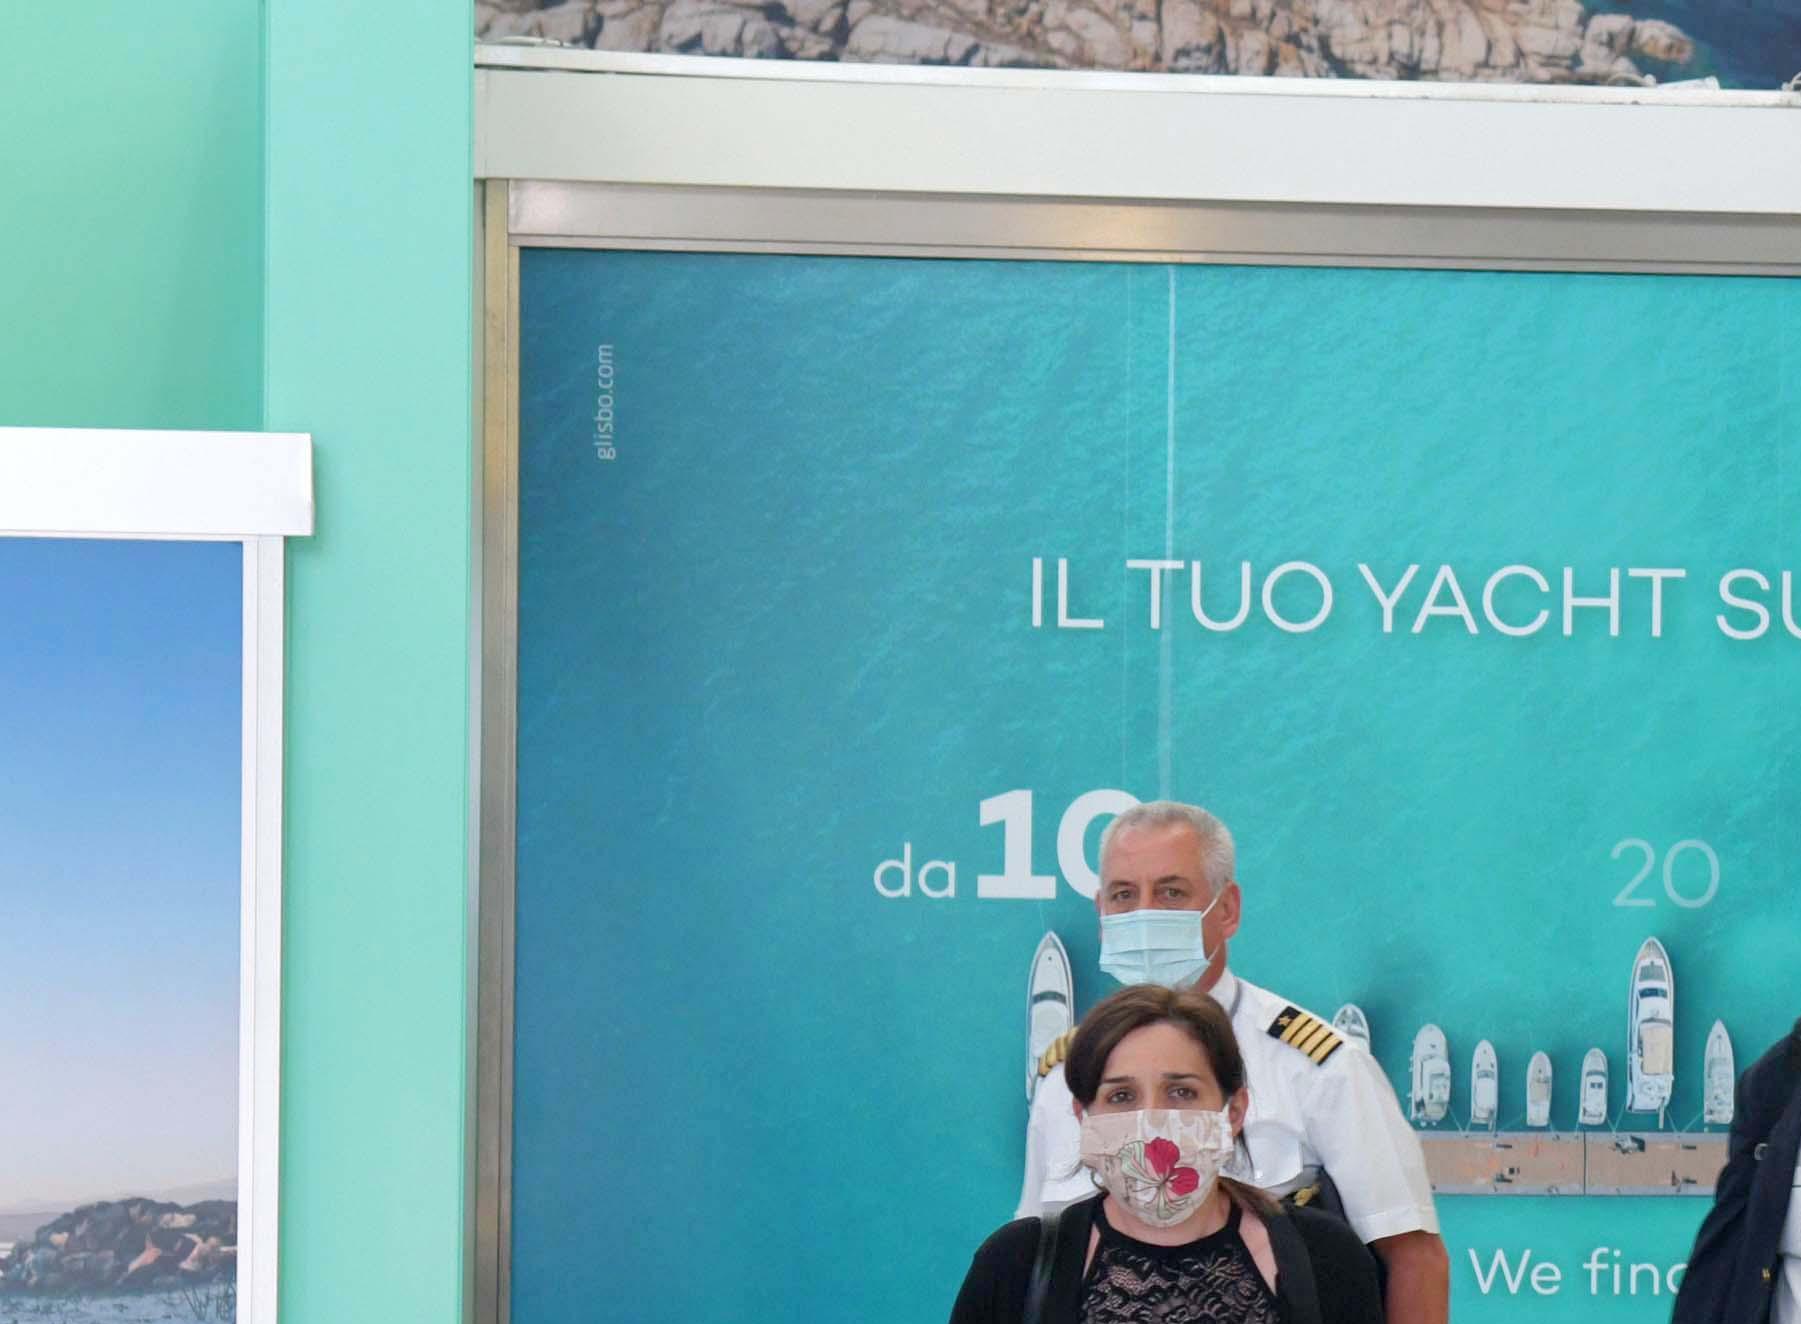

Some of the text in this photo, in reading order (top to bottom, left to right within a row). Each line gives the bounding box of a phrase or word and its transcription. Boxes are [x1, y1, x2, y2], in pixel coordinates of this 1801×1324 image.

[593, 344, 617, 460] glisbo.com
[1031, 557, 1104, 629] IL
[1126, 558, 1333, 632] TUO
[1357, 562, 1687, 638] YACHT
[873, 842, 956, 898] da
[1610, 838, 1721, 909] 20
[1467, 1247, 1563, 1296] We
